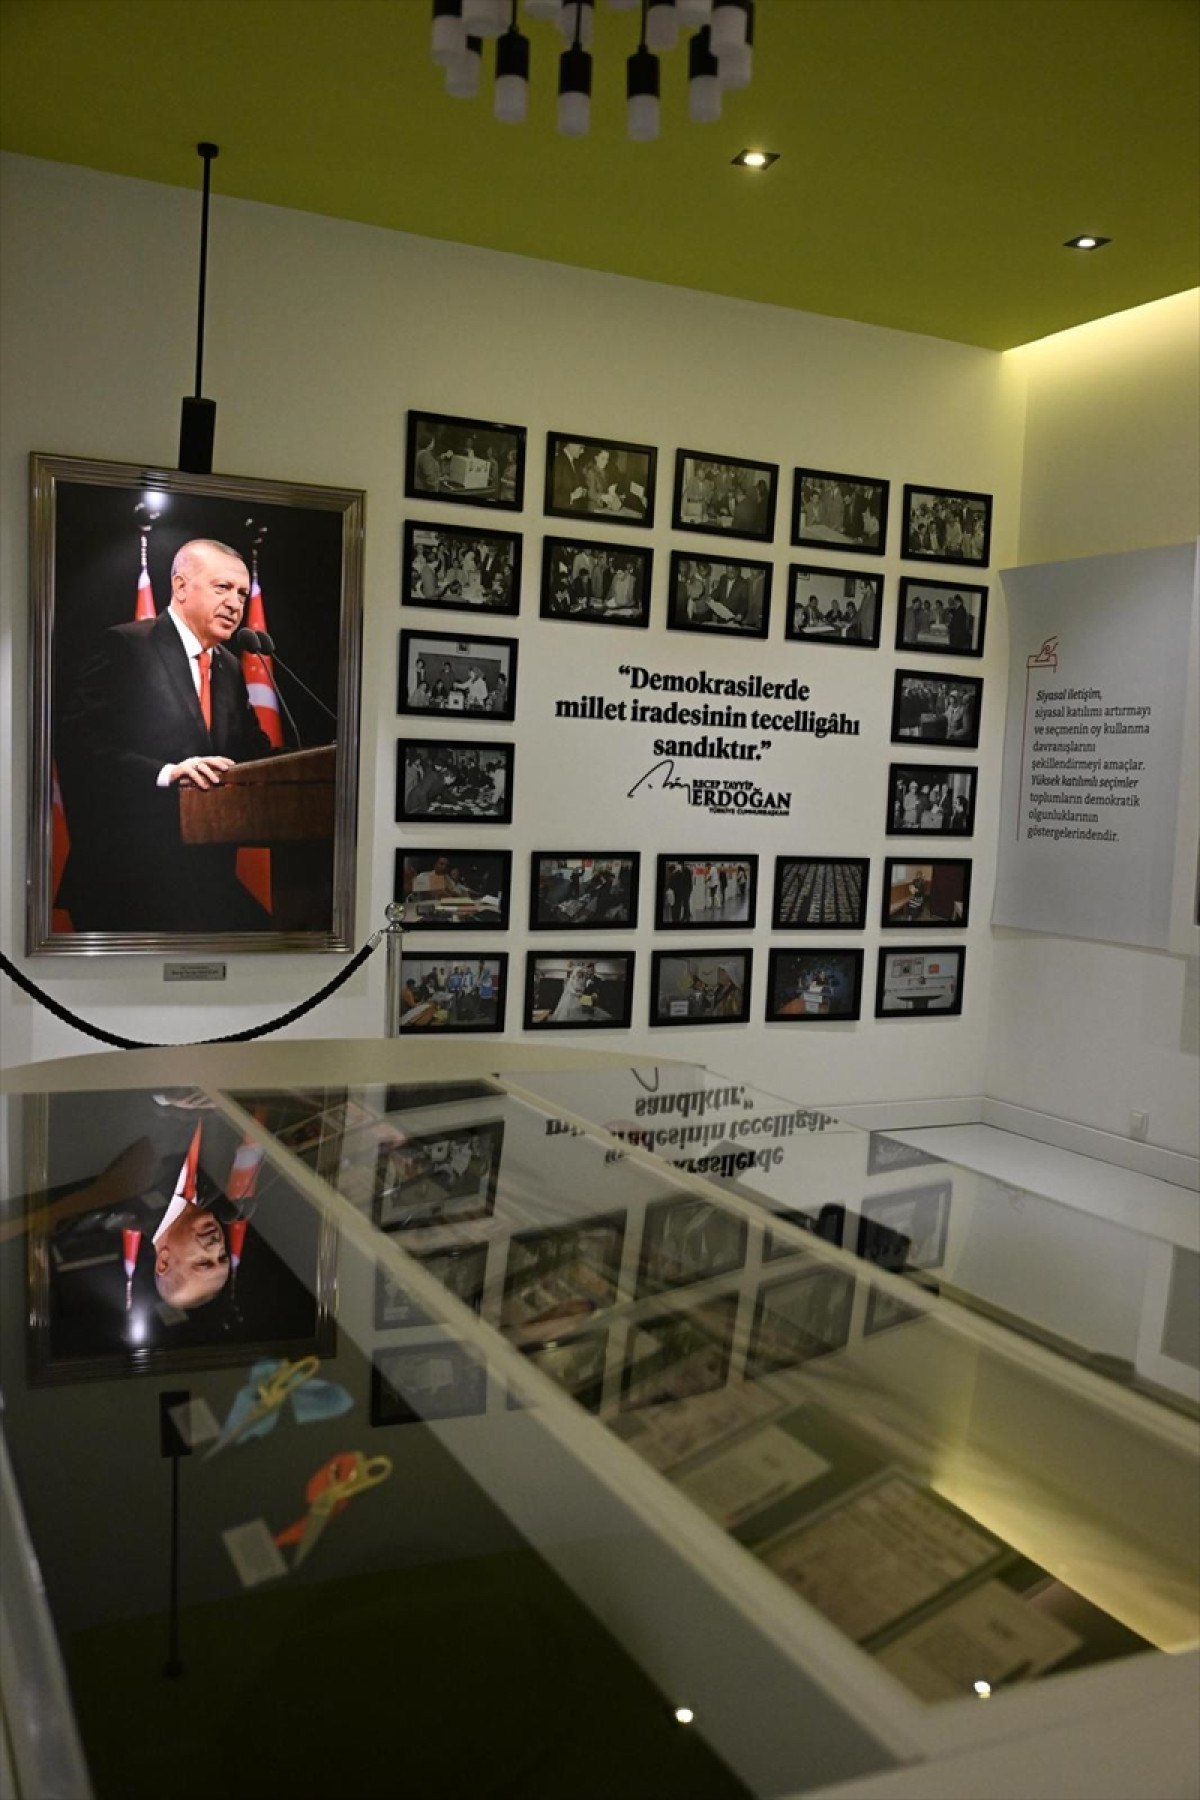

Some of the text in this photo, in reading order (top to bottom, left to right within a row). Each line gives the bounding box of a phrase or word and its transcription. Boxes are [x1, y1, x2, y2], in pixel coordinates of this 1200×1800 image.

[619, 664, 810, 700] “Demokrasilerde
[555, 696, 860, 738] millet iradesinin tecelligâhı
[1035, 705, 1151, 719] siyasal katılımı artırmayı
[1035, 722, 1149, 737] ve seçmenin oy kullanma
[653, 736, 771, 760] sandıktır.”
[1033, 740, 1095, 754] davranışlarını
[1032, 758, 1146, 772] şekillendirmeyi amaçlar.
[693, 779, 721, 789] RECEP
[1031, 776, 1061, 787] Yüksek
[1099, 778, 1139, 790] seçimler
[691, 787, 792, 809] ERDOĞAN
[1030, 793, 1140, 807] toplumların demokratik
[1029, 809, 1098, 823] olgunluklarının
[1027, 826, 1119, 842] göstergelerindendir.
